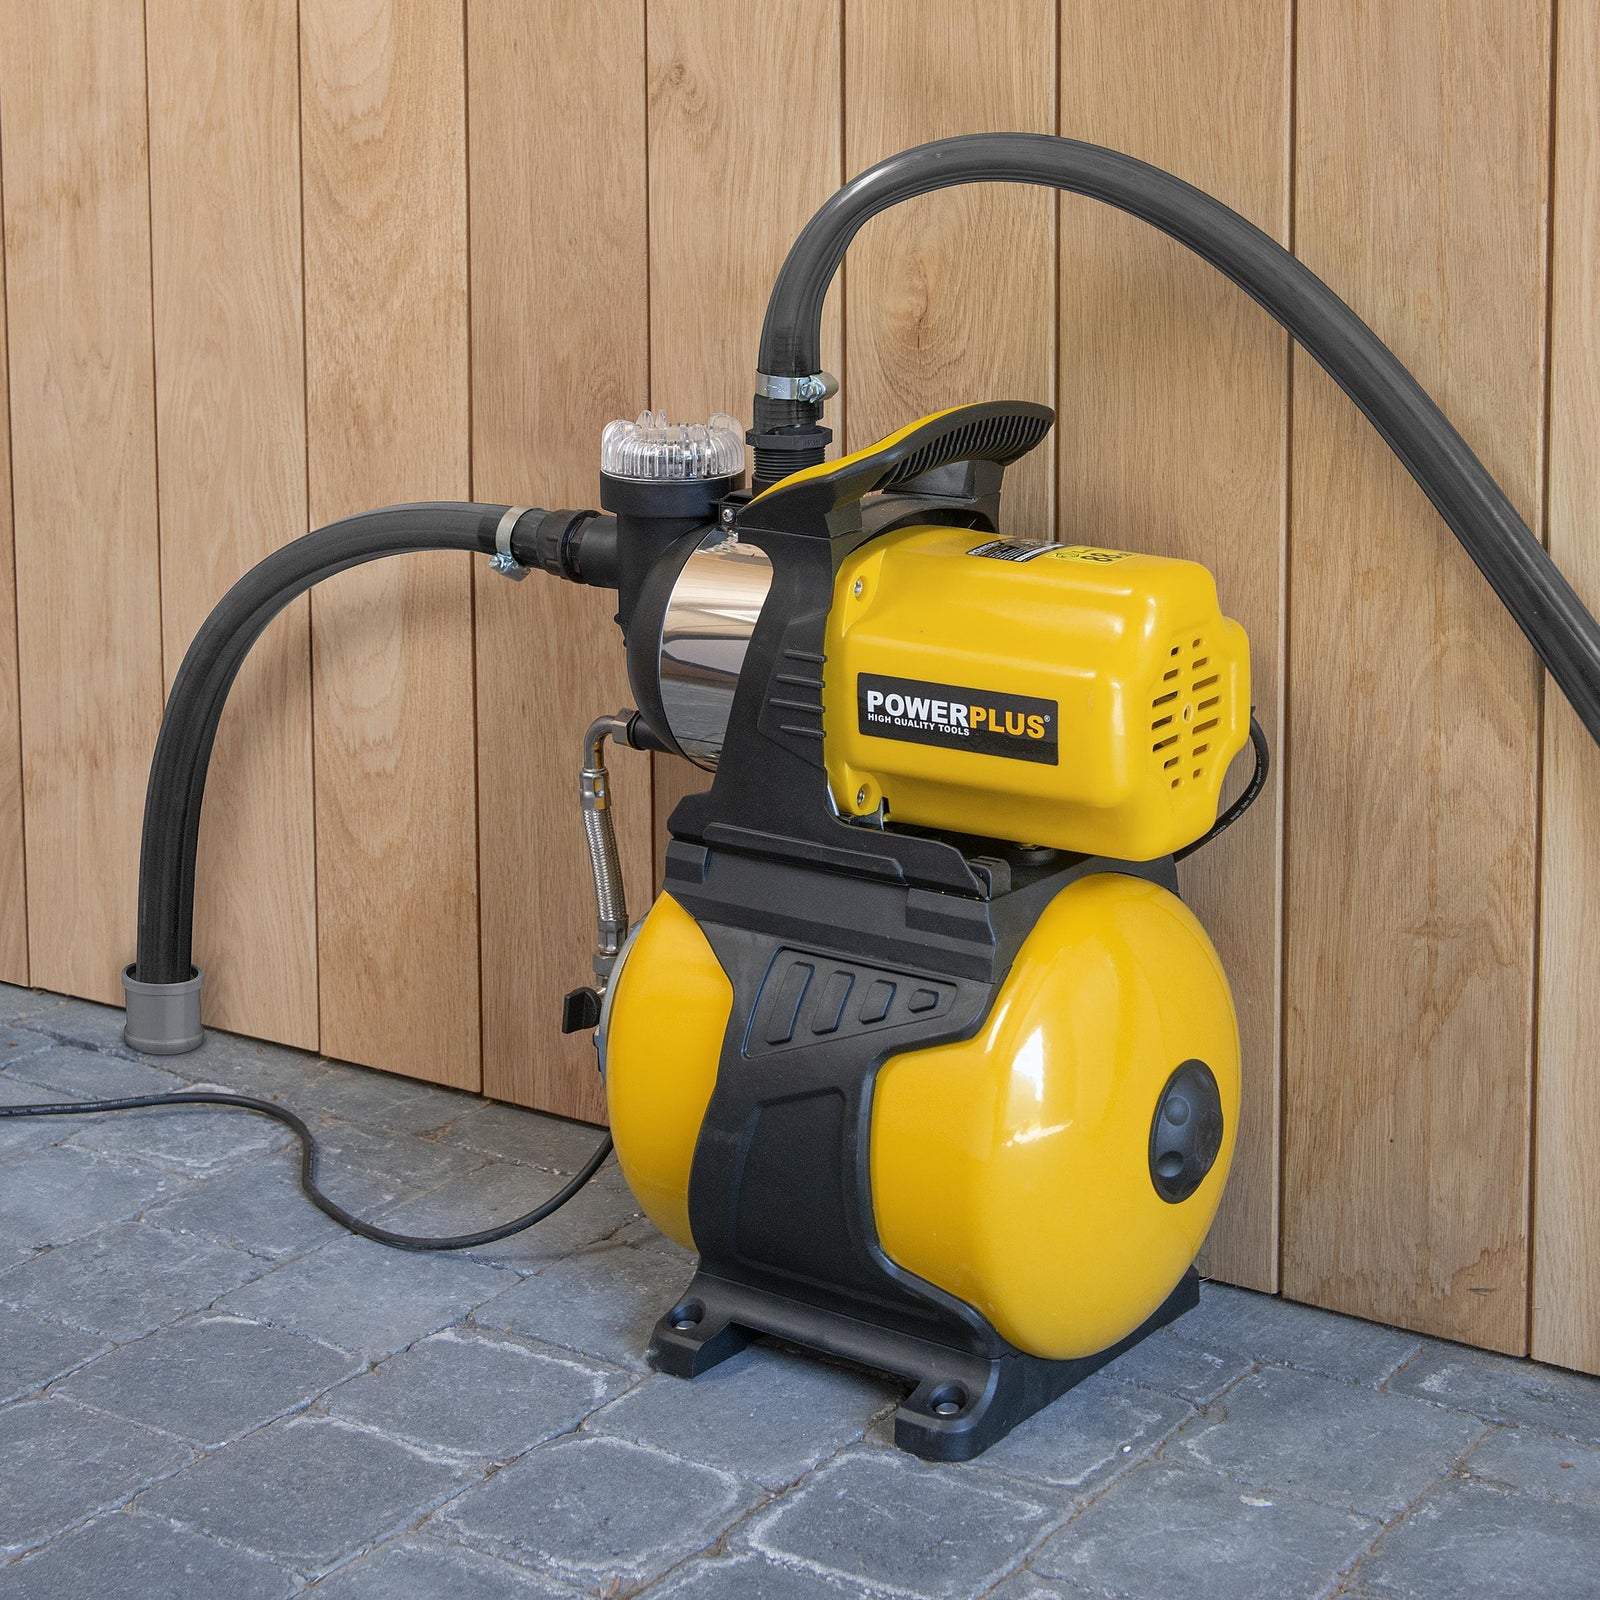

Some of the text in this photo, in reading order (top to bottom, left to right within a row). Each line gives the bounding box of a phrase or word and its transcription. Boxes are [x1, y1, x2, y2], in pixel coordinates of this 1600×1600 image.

[867, 712, 970, 737] HIGH QUALITY TOOLS
